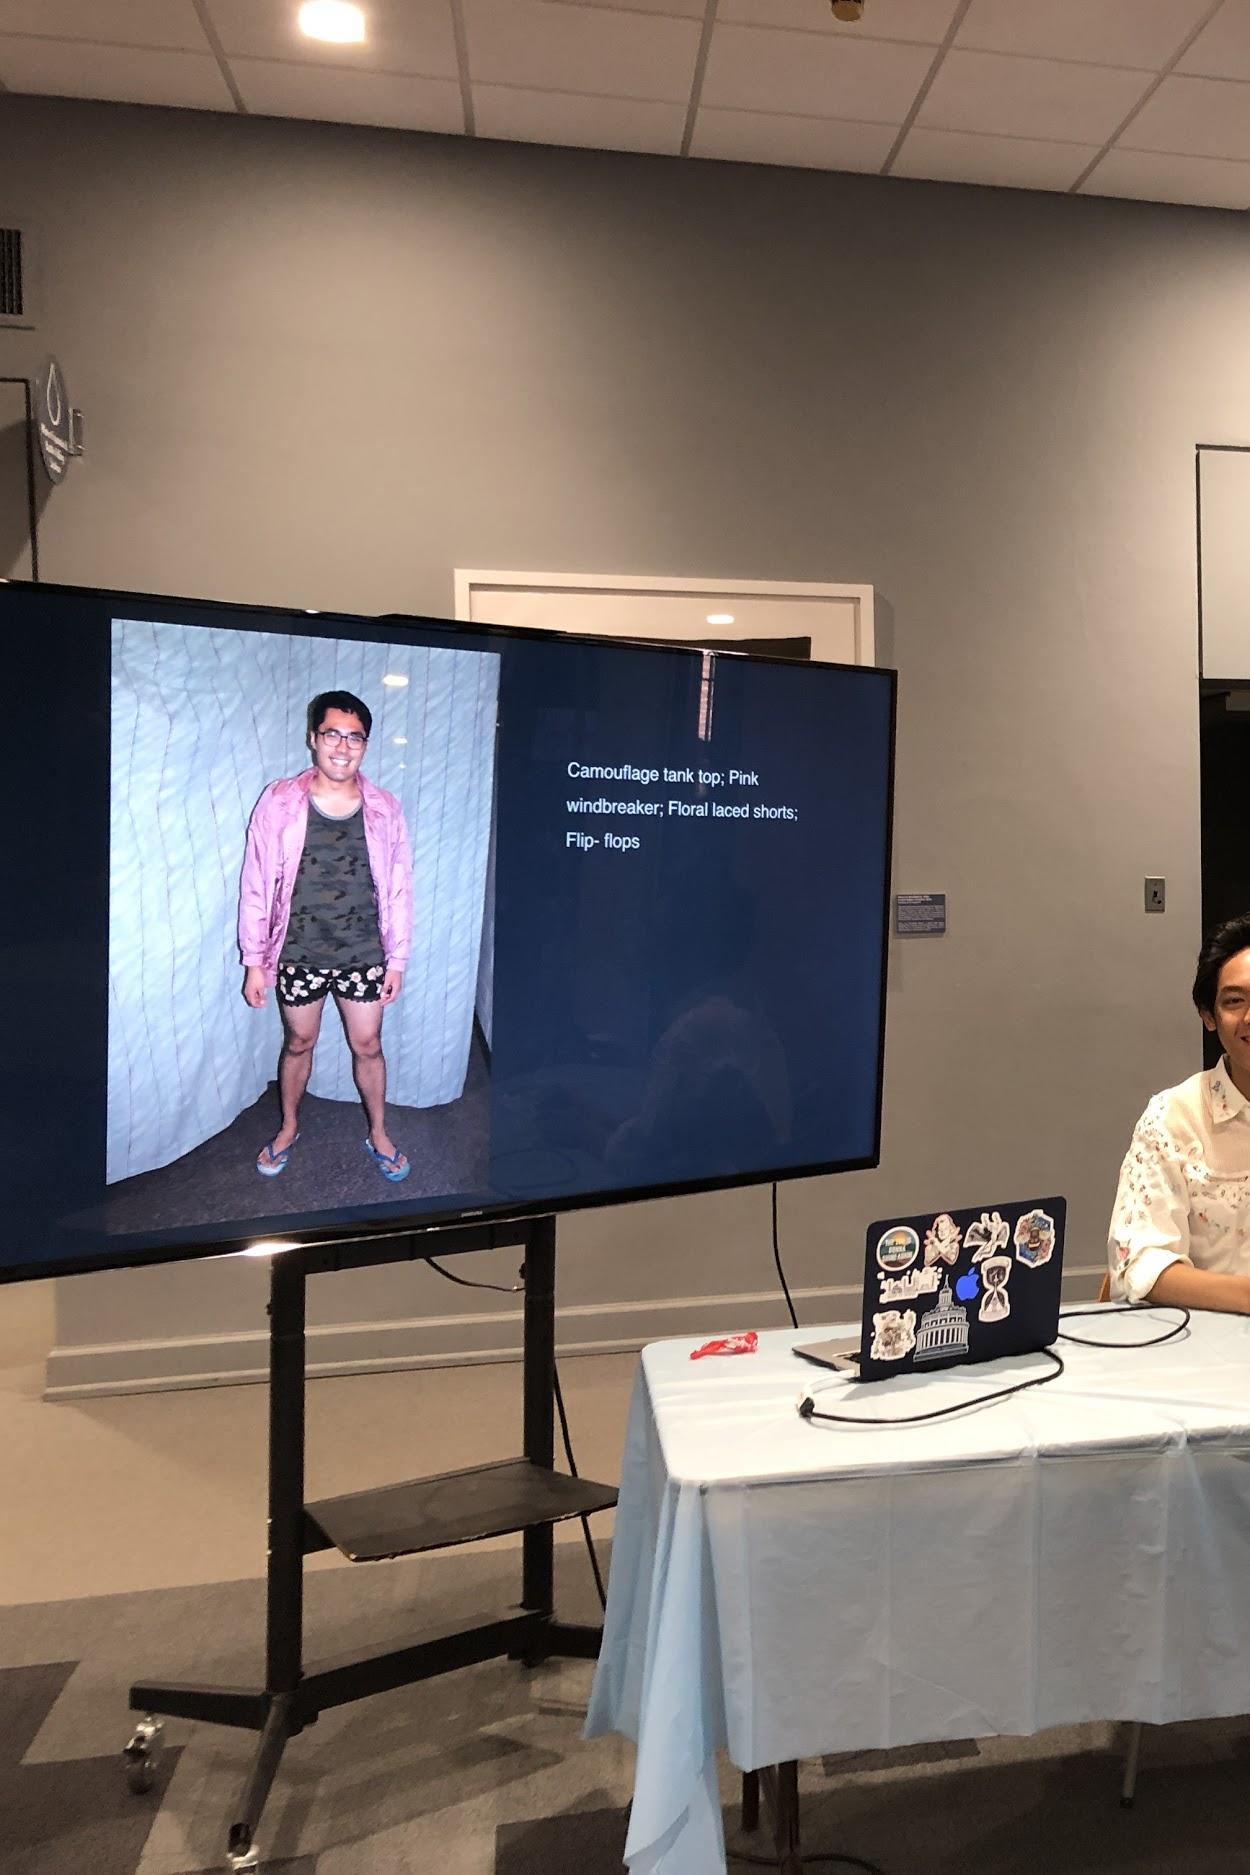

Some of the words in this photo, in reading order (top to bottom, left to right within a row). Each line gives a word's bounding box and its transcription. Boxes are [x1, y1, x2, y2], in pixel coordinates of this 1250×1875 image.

[567, 761, 660, 785] Camouflage
[663, 767, 695, 783] tank
[698, 768, 725, 787] top;
[729, 769, 759, 786] Pink
[566, 797, 664, 818] windbreaker;
[668, 800, 709, 817] Floral
[712, 802, 750, 818] laced
[753, 803, 799, 822] shorts;
[566, 831, 600, 851] Flip-
[604, 832, 641, 852] flops
